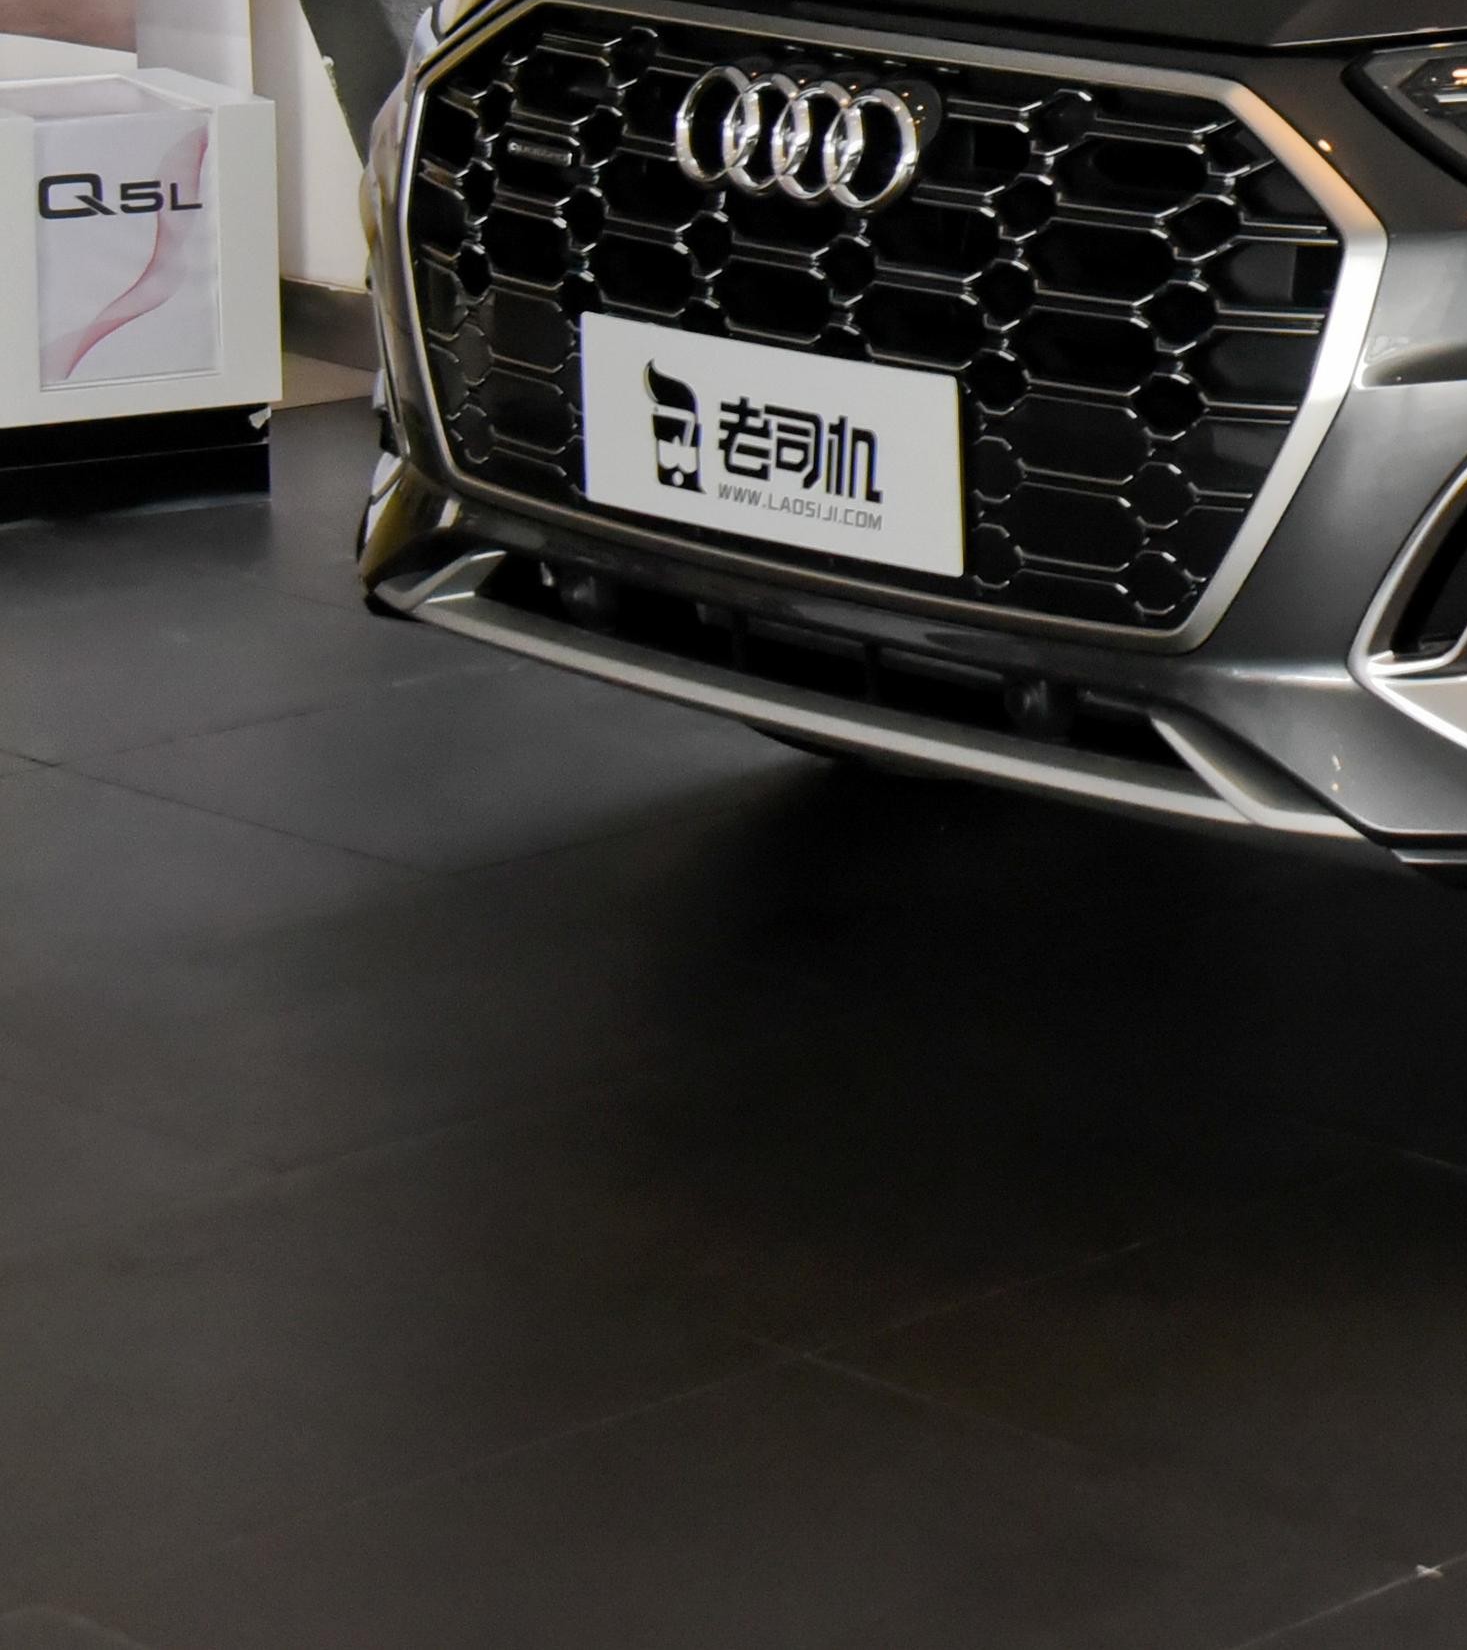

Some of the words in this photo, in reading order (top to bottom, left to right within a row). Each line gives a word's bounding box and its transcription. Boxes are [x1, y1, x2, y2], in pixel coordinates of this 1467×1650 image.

[38, 173, 203, 219] Q5L
[718, 396, 883, 503] 老司机
[718, 483, 883, 531] WWW.LAOSIJI.COM
